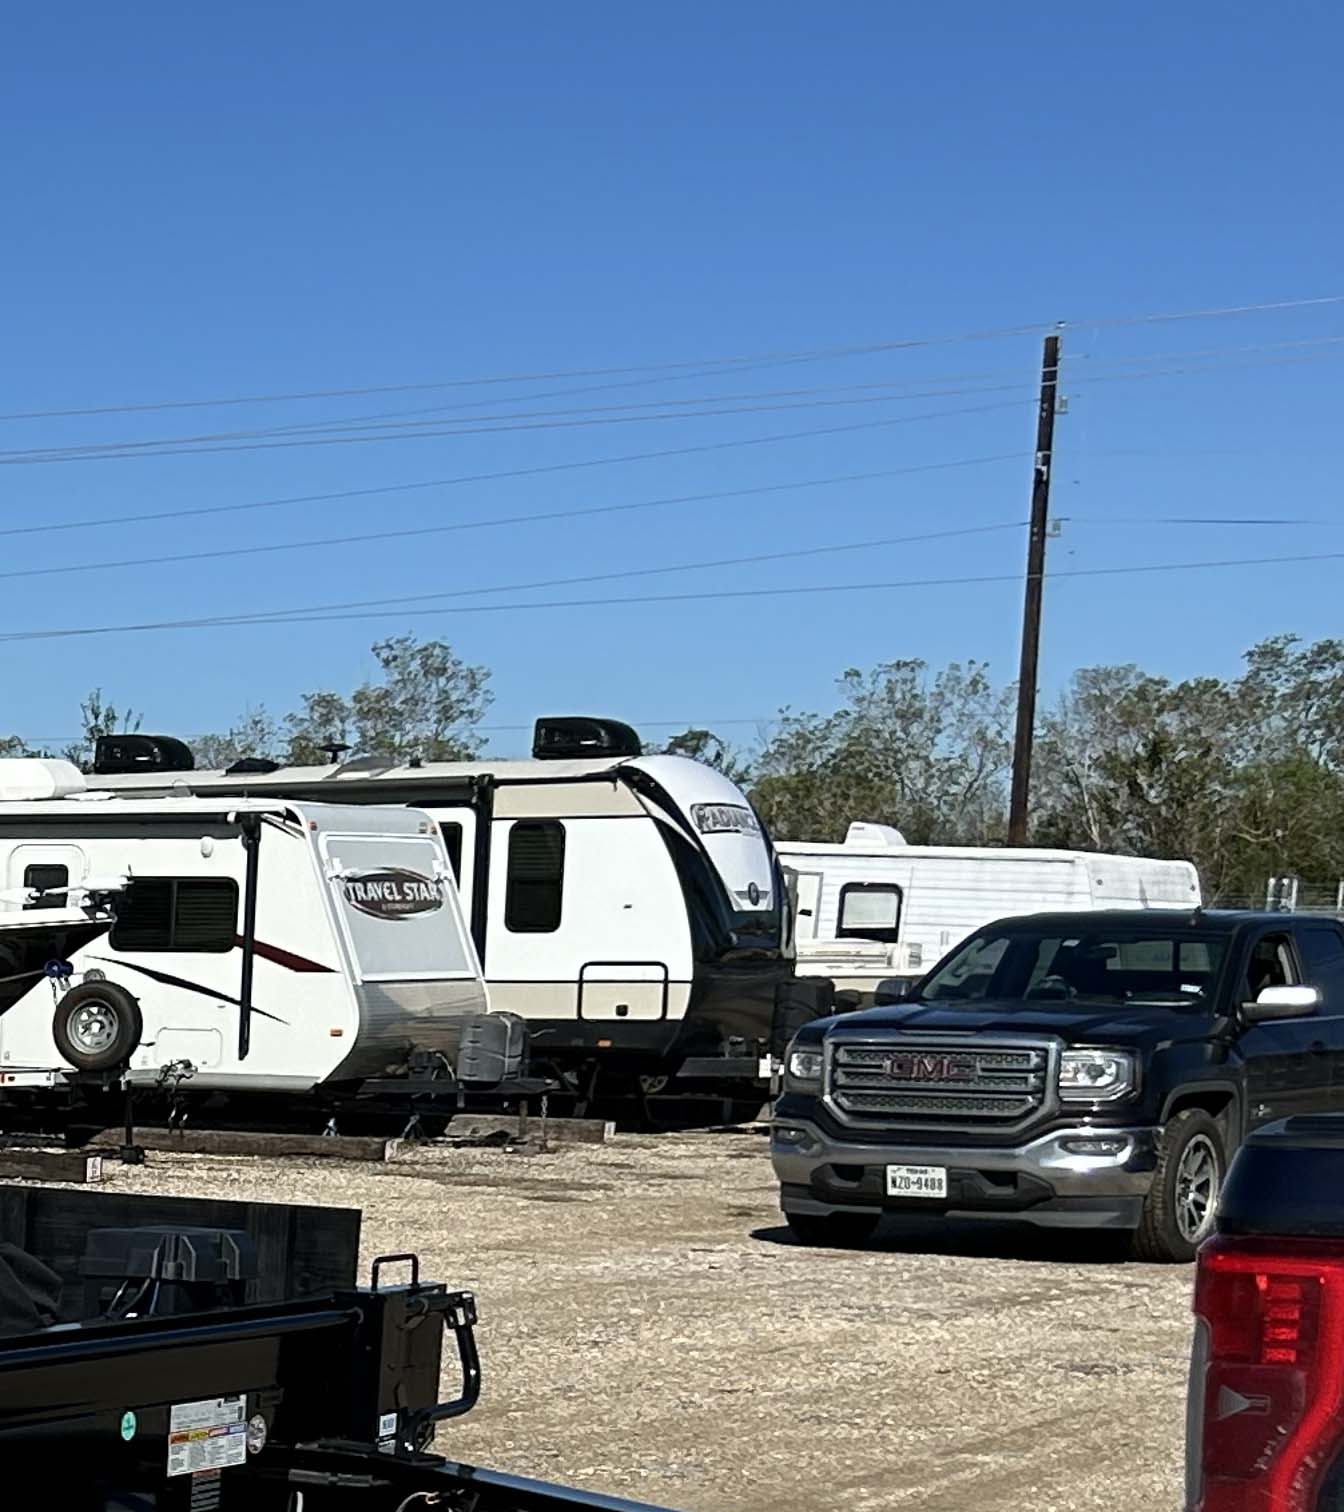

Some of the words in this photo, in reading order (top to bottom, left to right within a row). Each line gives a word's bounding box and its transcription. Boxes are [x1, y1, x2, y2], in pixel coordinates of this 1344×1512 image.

[346, 881, 402, 901] TRAVEL
[403, 881, 440, 901] STAR
[887, 1057, 977, 1079] GMC
